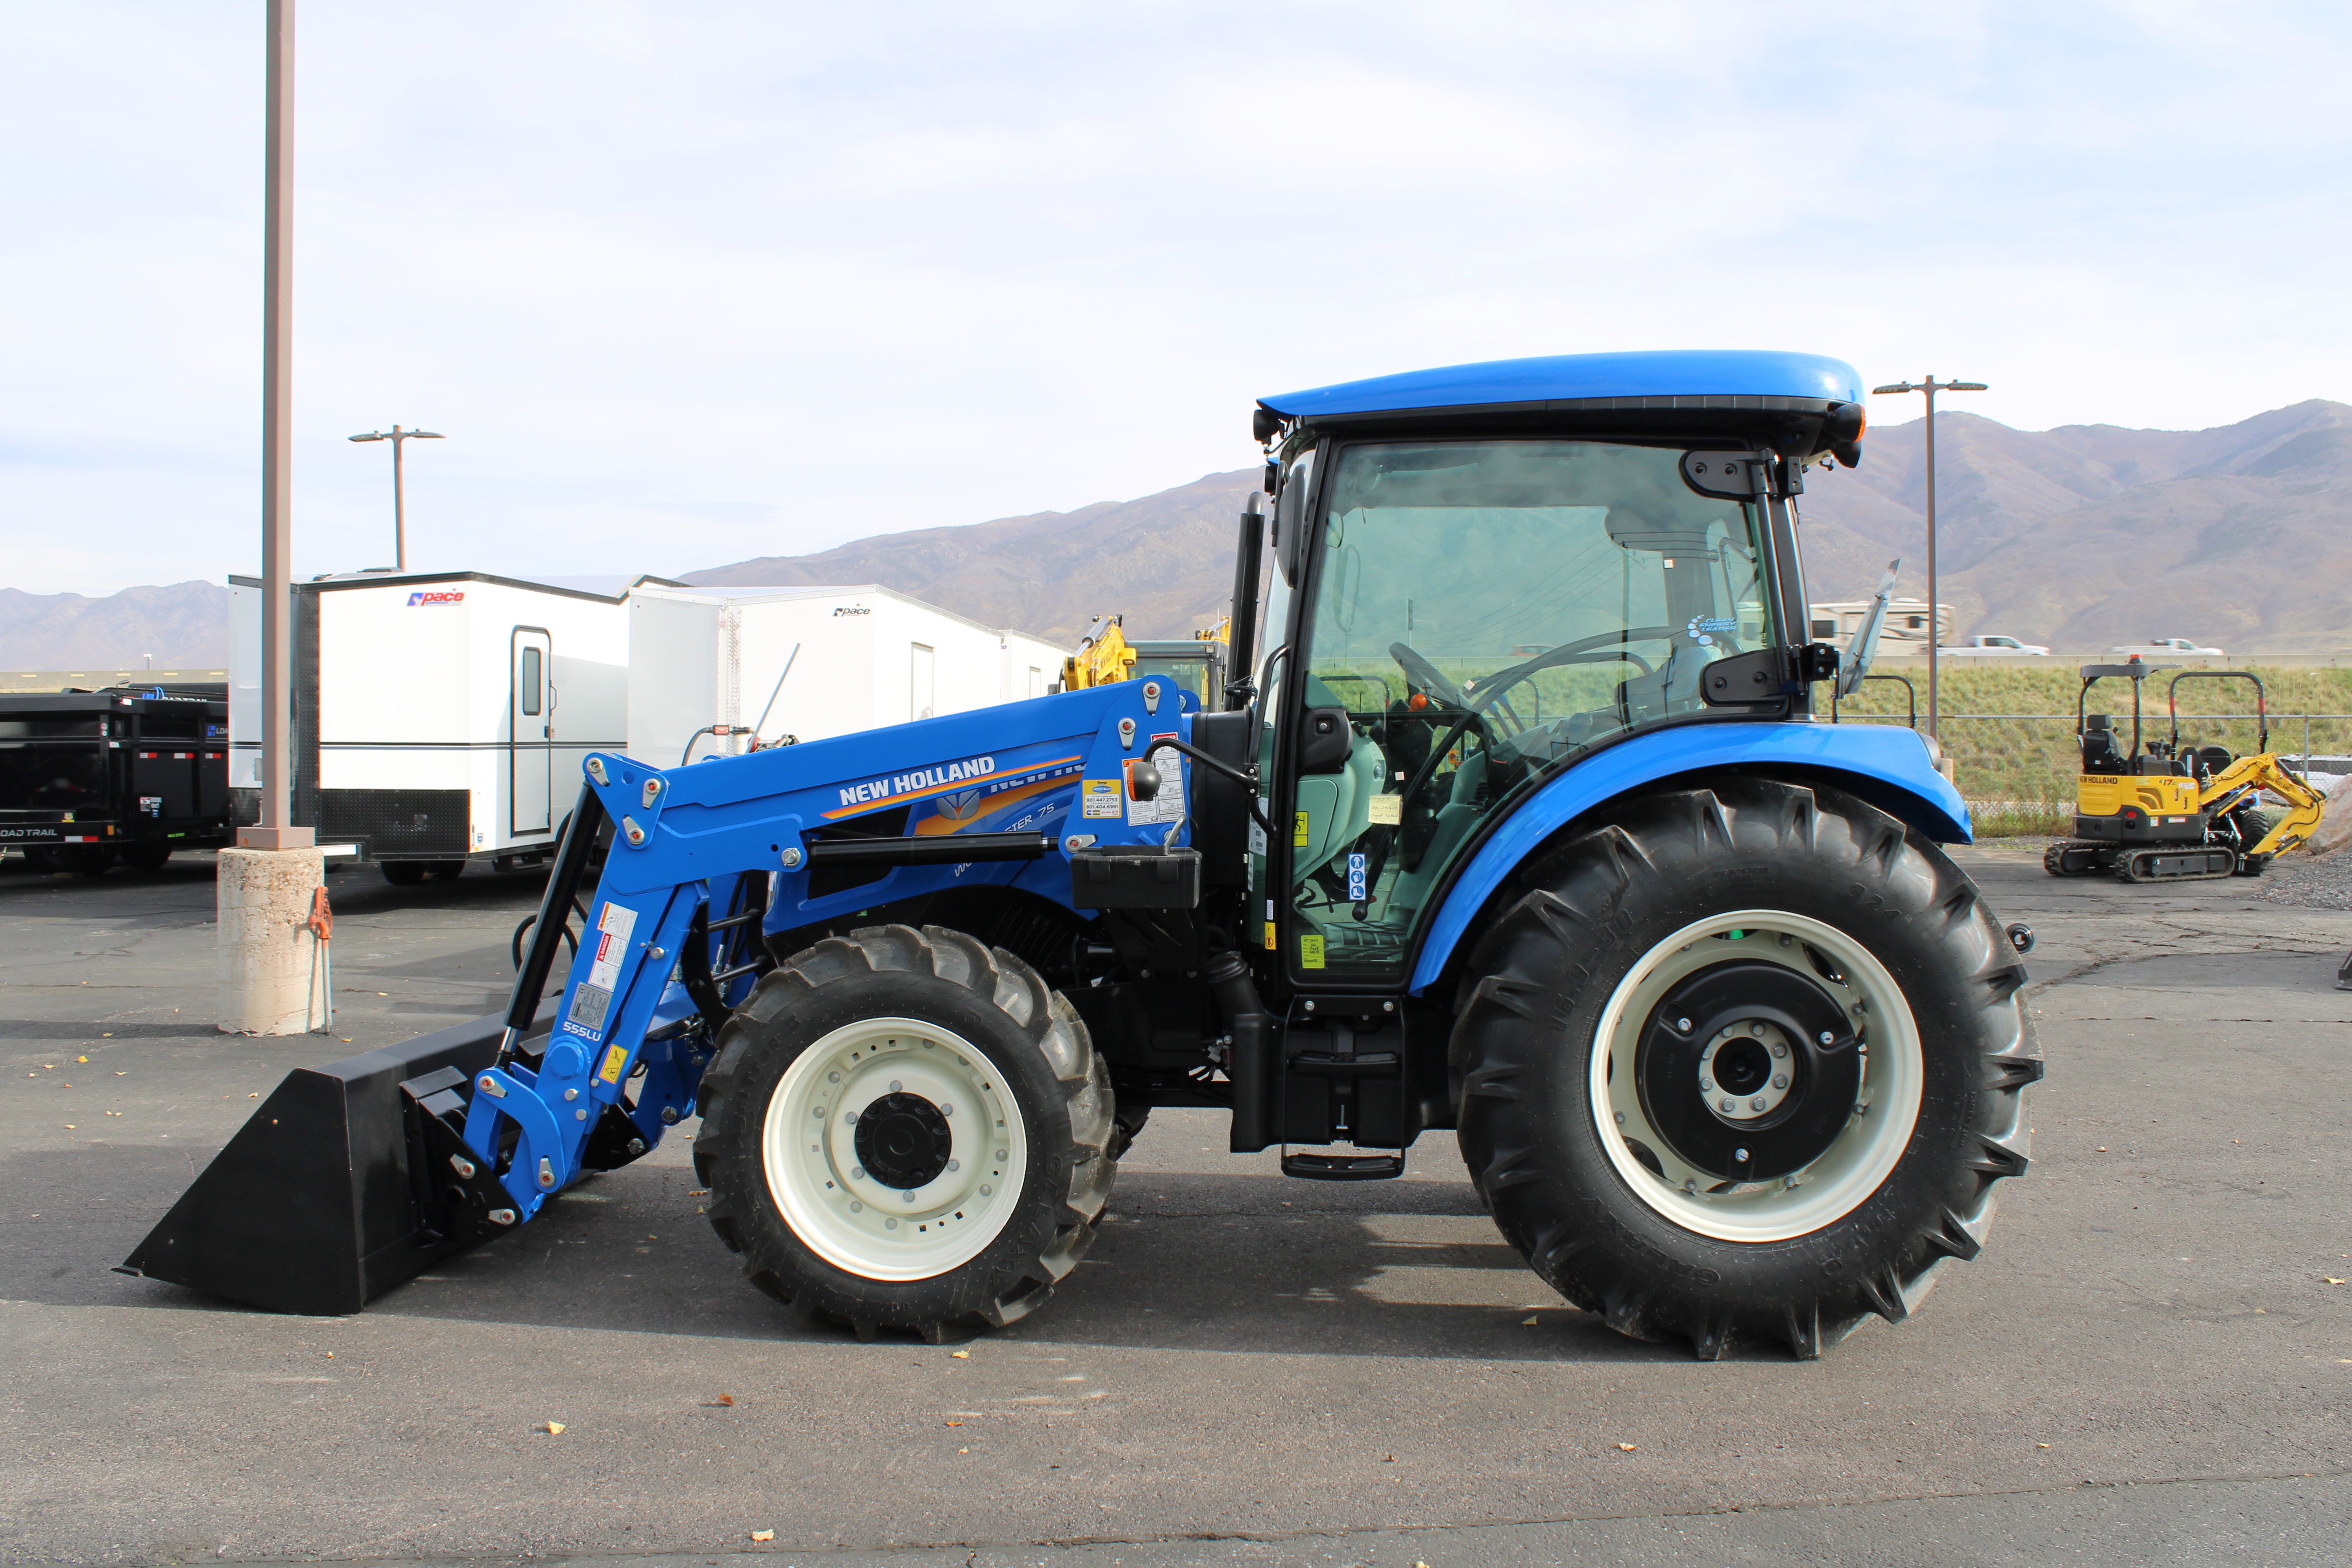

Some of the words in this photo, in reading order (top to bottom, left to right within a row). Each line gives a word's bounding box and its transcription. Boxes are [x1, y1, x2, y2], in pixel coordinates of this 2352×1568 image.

[421, 592, 464, 606] pace
[842, 608, 870, 617] pace
[840, 779, 889, 806] NEW
[893, 756, 996, 794] HOLLAND
[1038, 803, 1054, 818] 75
[600, 935, 610, 955] DANGER
[563, 1021, 601, 1042] 555LU
[1581, 1196, 1721, 1285] GALAXY
